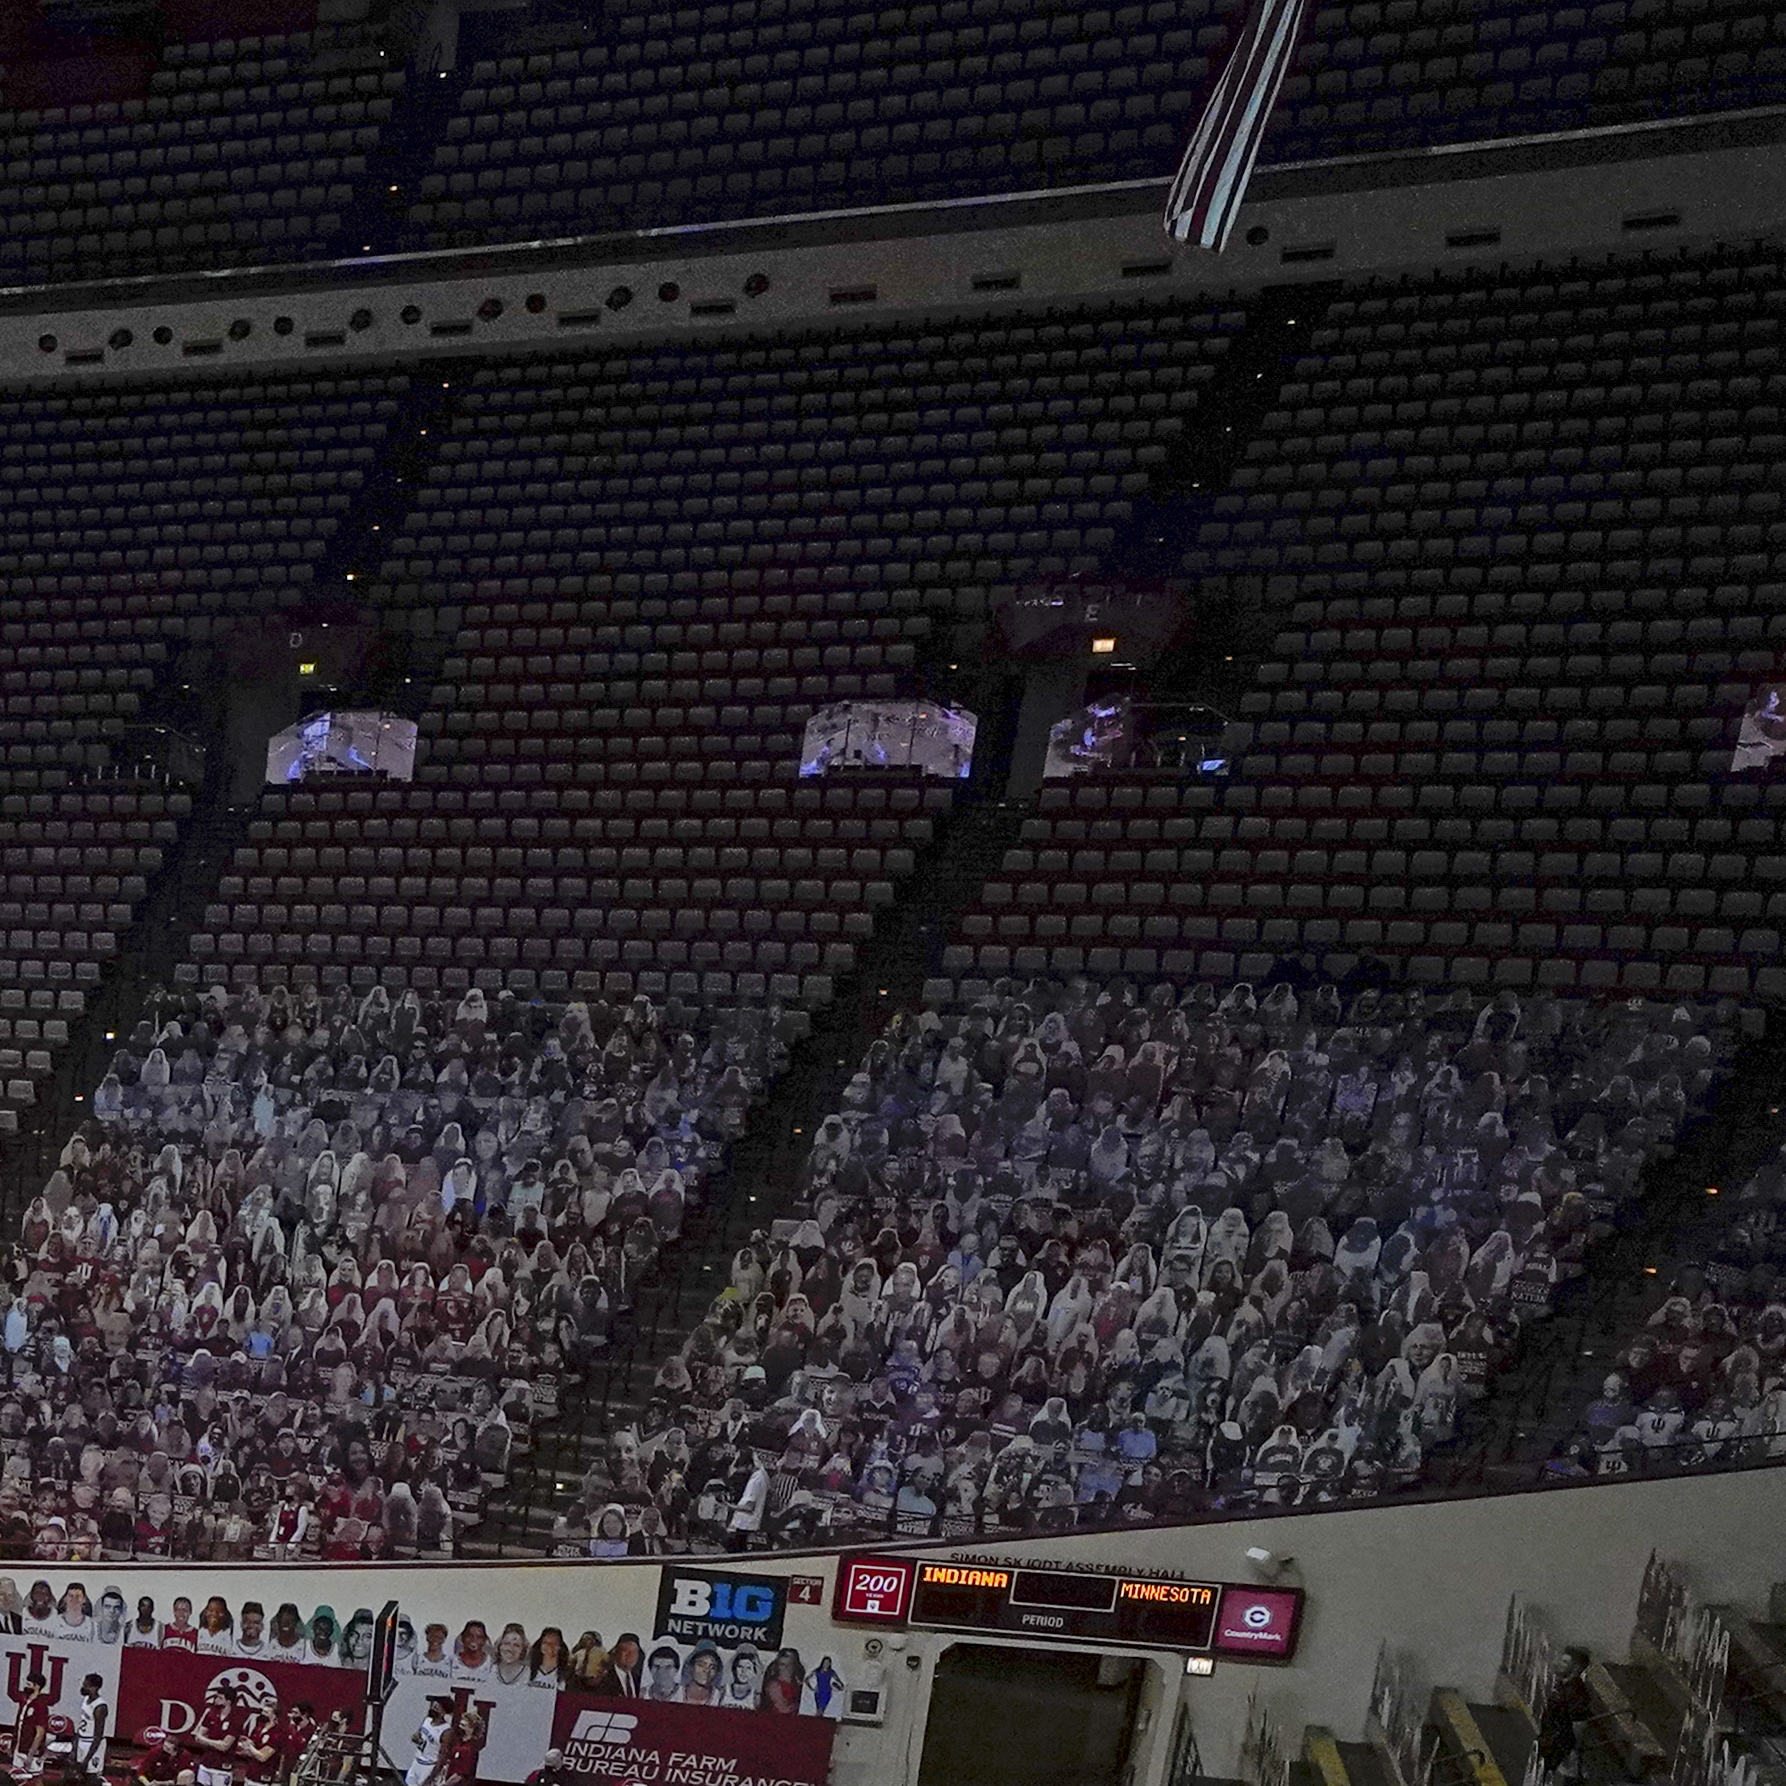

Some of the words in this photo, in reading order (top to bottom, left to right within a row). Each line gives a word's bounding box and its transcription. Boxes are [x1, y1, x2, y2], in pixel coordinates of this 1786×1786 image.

[855, 1574, 898, 1593] 200
[923, 1566, 1008, 1589] INDIANA
[1120, 1583, 1212, 1605] MINNESOTA
[799, 1586, 811, 1602] 4
[668, 1619, 767, 1641] NETWORK
[1022, 1614, 1064, 1629] PERIOD
[1224, 1630, 1282, 1641] CountryMark
[564, 1741, 660, 1764] INDIANA
[667, 1752, 737, 1773] FARM
[561, 1756, 660, 1780] BUREAU
